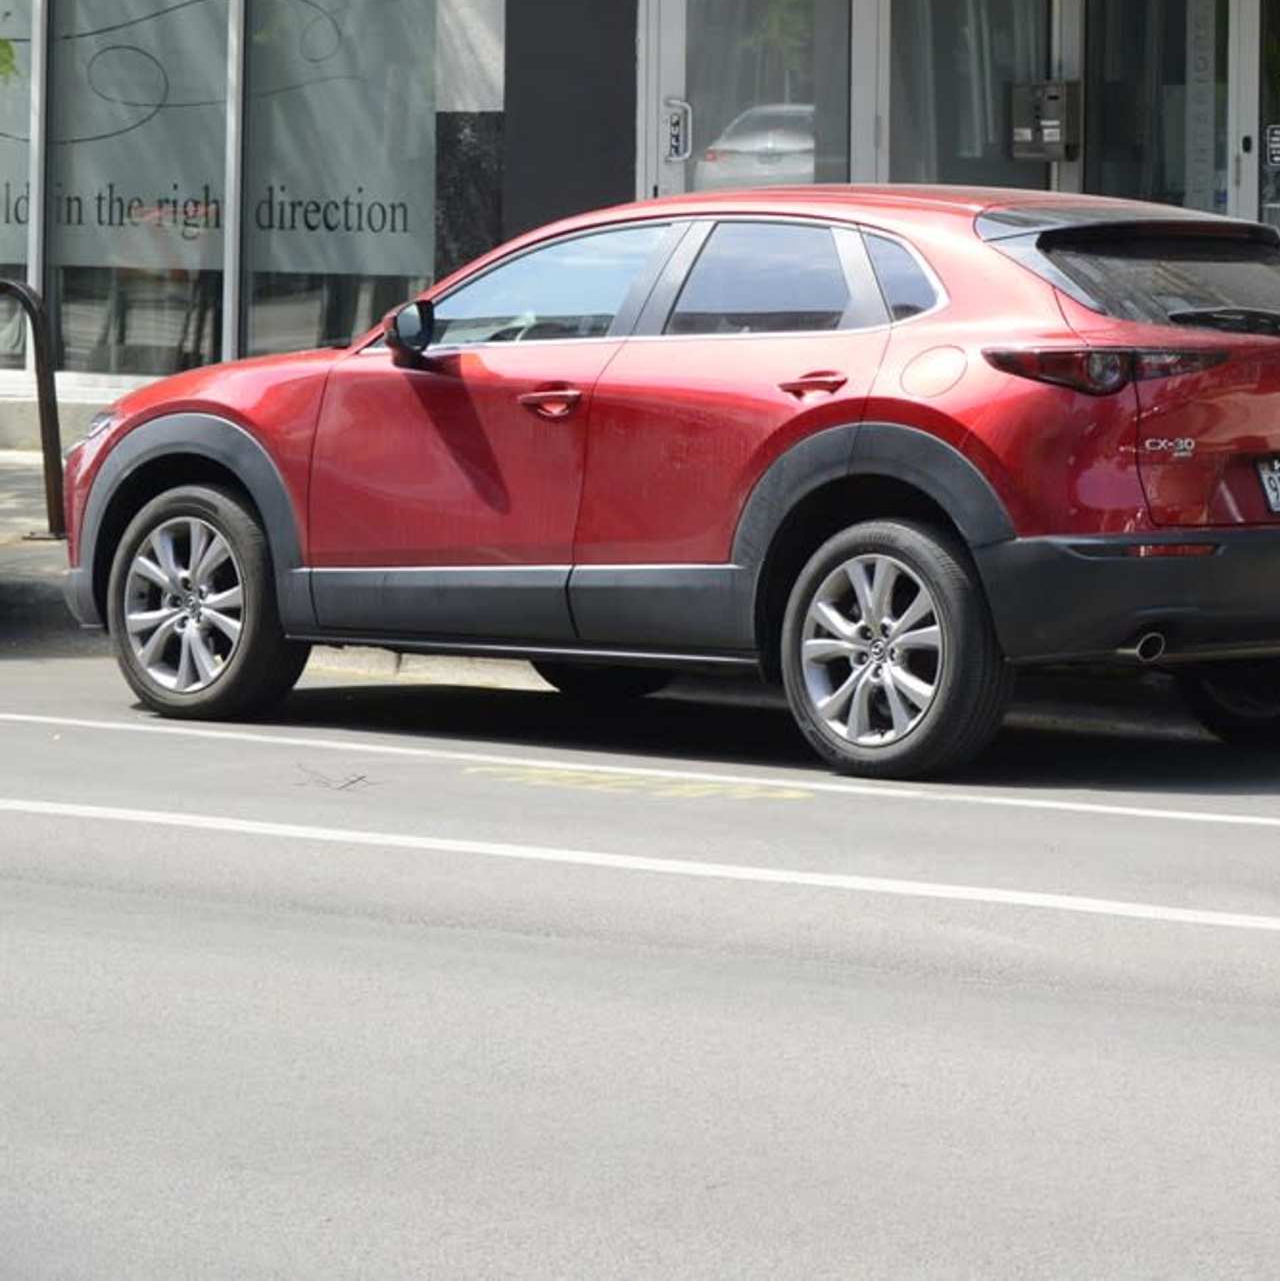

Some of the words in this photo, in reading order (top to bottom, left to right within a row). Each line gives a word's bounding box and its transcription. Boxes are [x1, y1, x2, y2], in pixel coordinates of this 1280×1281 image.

[56, 182, 83, 226] in
[96, 182, 142, 227] the
[156, 183, 222, 240] righ
[256, 185, 409, 235] direction
[1145, 438, 1195, 451] CX-30
